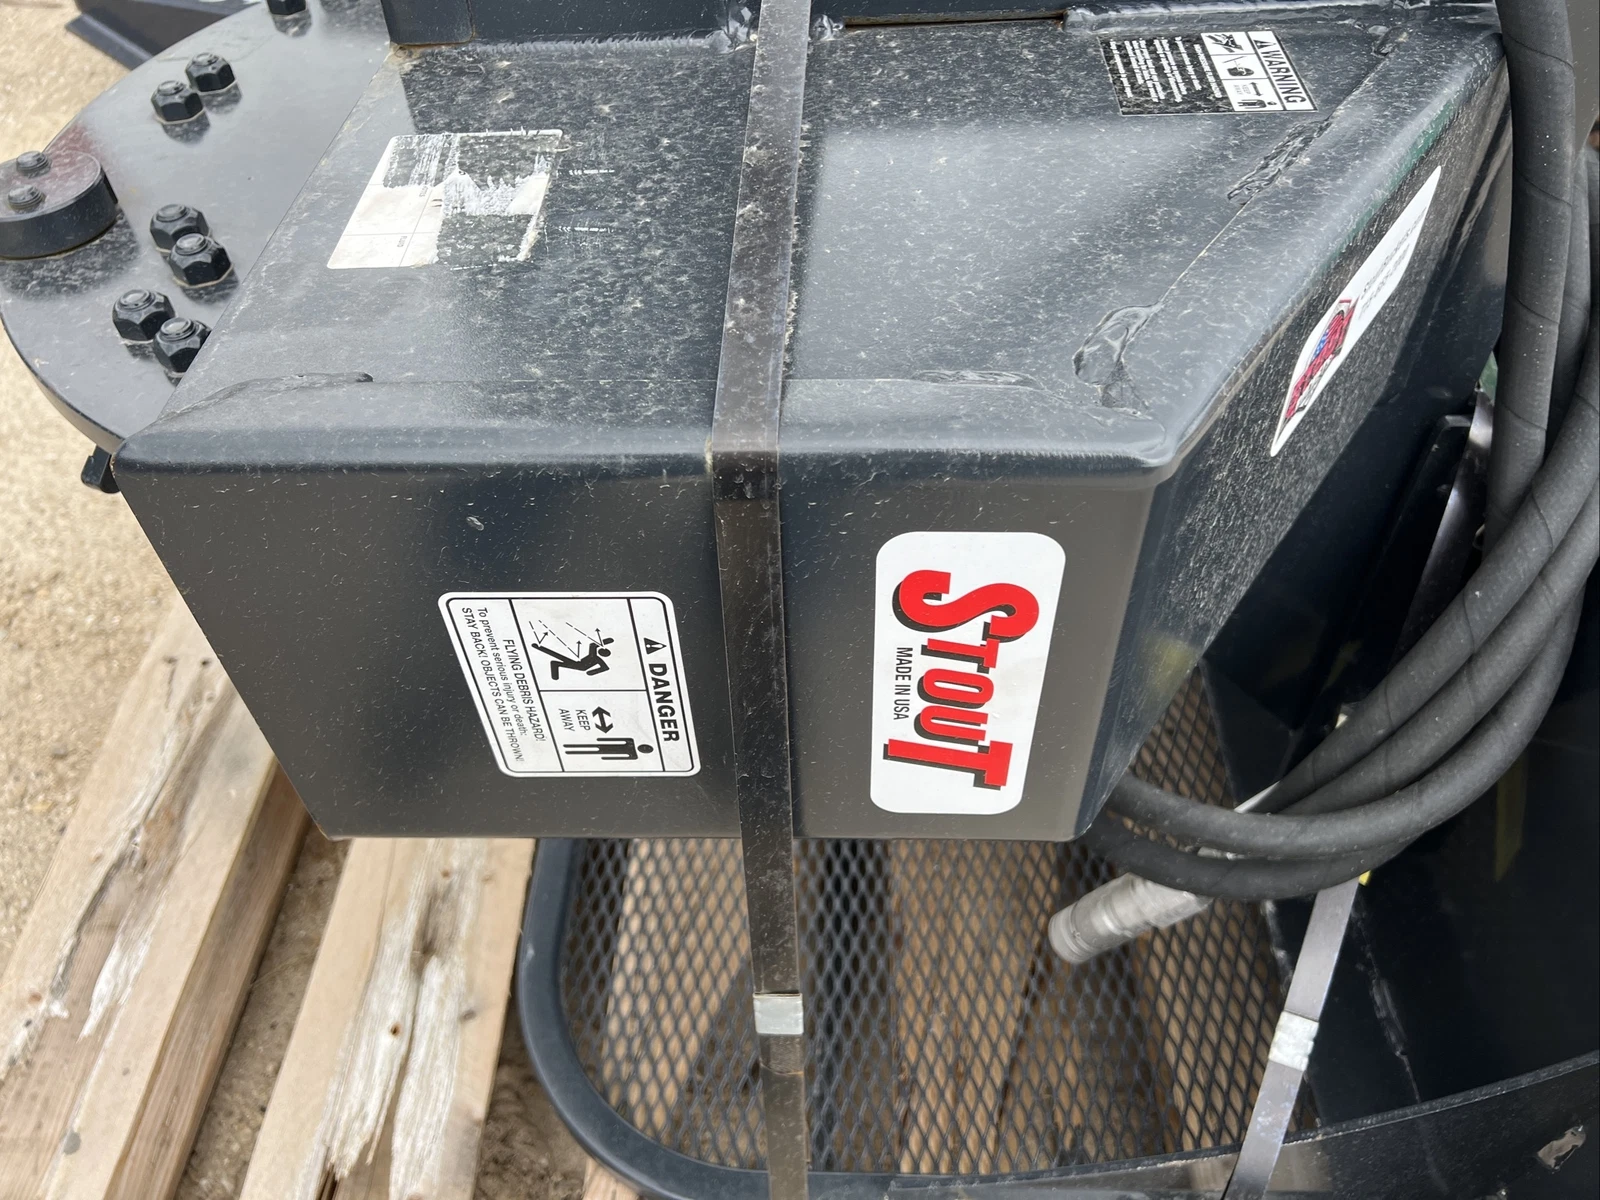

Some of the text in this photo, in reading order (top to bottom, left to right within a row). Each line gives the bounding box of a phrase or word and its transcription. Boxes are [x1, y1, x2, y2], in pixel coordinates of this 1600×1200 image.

[1260, 49, 1306, 103] WARNING
[462, 607, 525, 762] STAY BACK! OBJECTS CAN BE THROWN!
[477, 607, 528, 736] To prevent serious injury or death:
[503, 639, 546, 742] FLYING DEBRIS HAZARD!
[648, 663, 680, 742] DANGER
[883, 569, 1040, 791] STOUT
[893, 646, 913, 721] MADE IN USA
[558, 708, 575, 732] AWAY
[575, 709, 591, 731] KEEP
